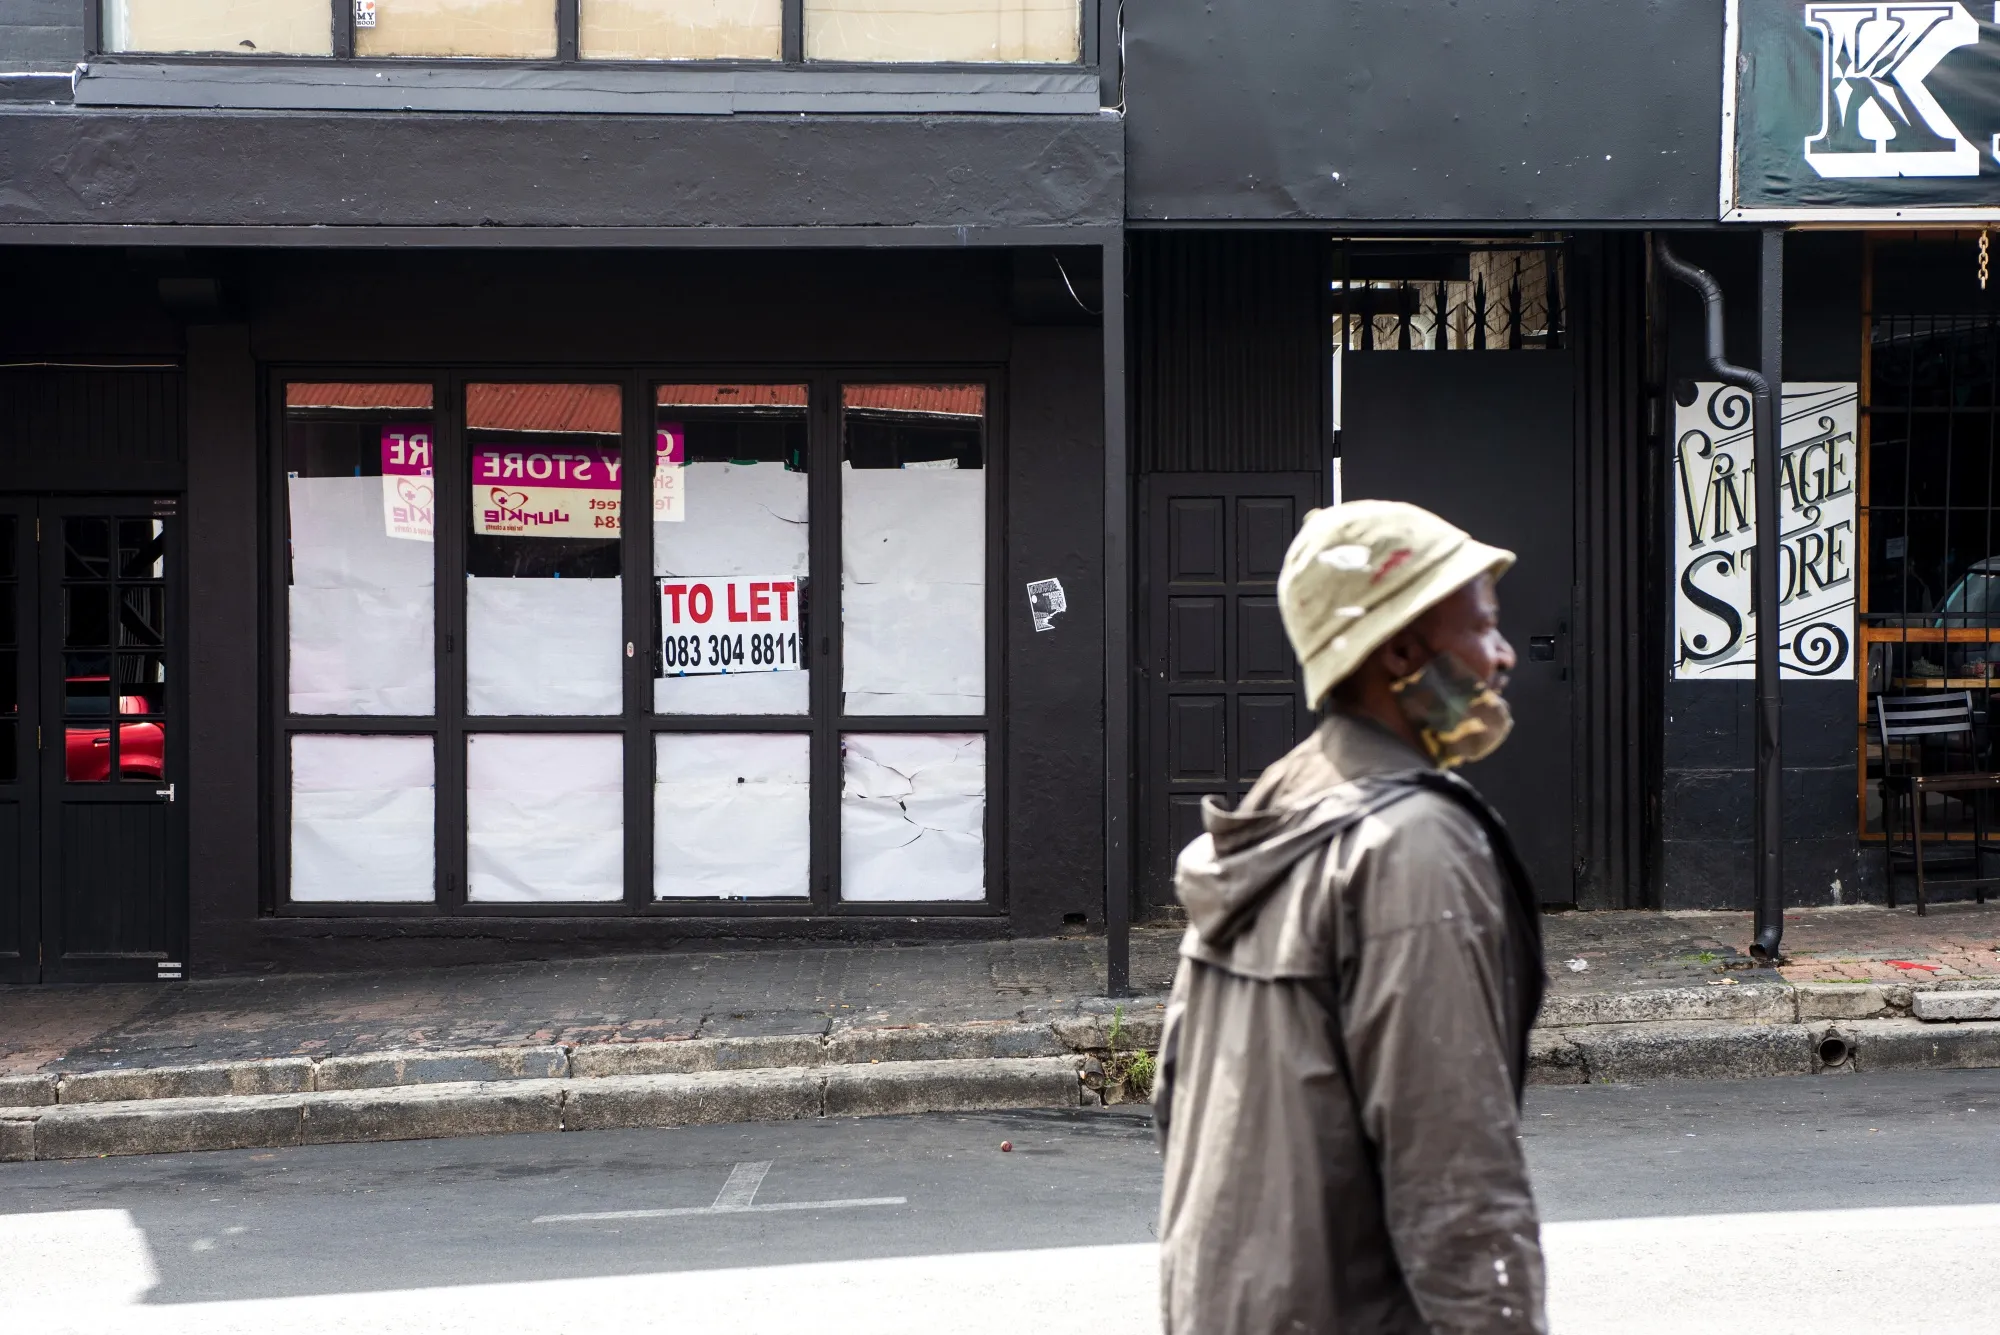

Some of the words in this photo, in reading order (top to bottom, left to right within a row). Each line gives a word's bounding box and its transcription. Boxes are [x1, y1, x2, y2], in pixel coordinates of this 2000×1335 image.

[357, 12, 374, 20] MY
[1804, 2, 2000, 178] K
[1677, 416, 1855, 550] VINAGE
[664, 583, 714, 624] TO
[727, 582, 796, 623] LET
[665, 635, 702, 667] 083
[708, 634, 745, 666] 304
[751, 632, 797, 665] 8811
